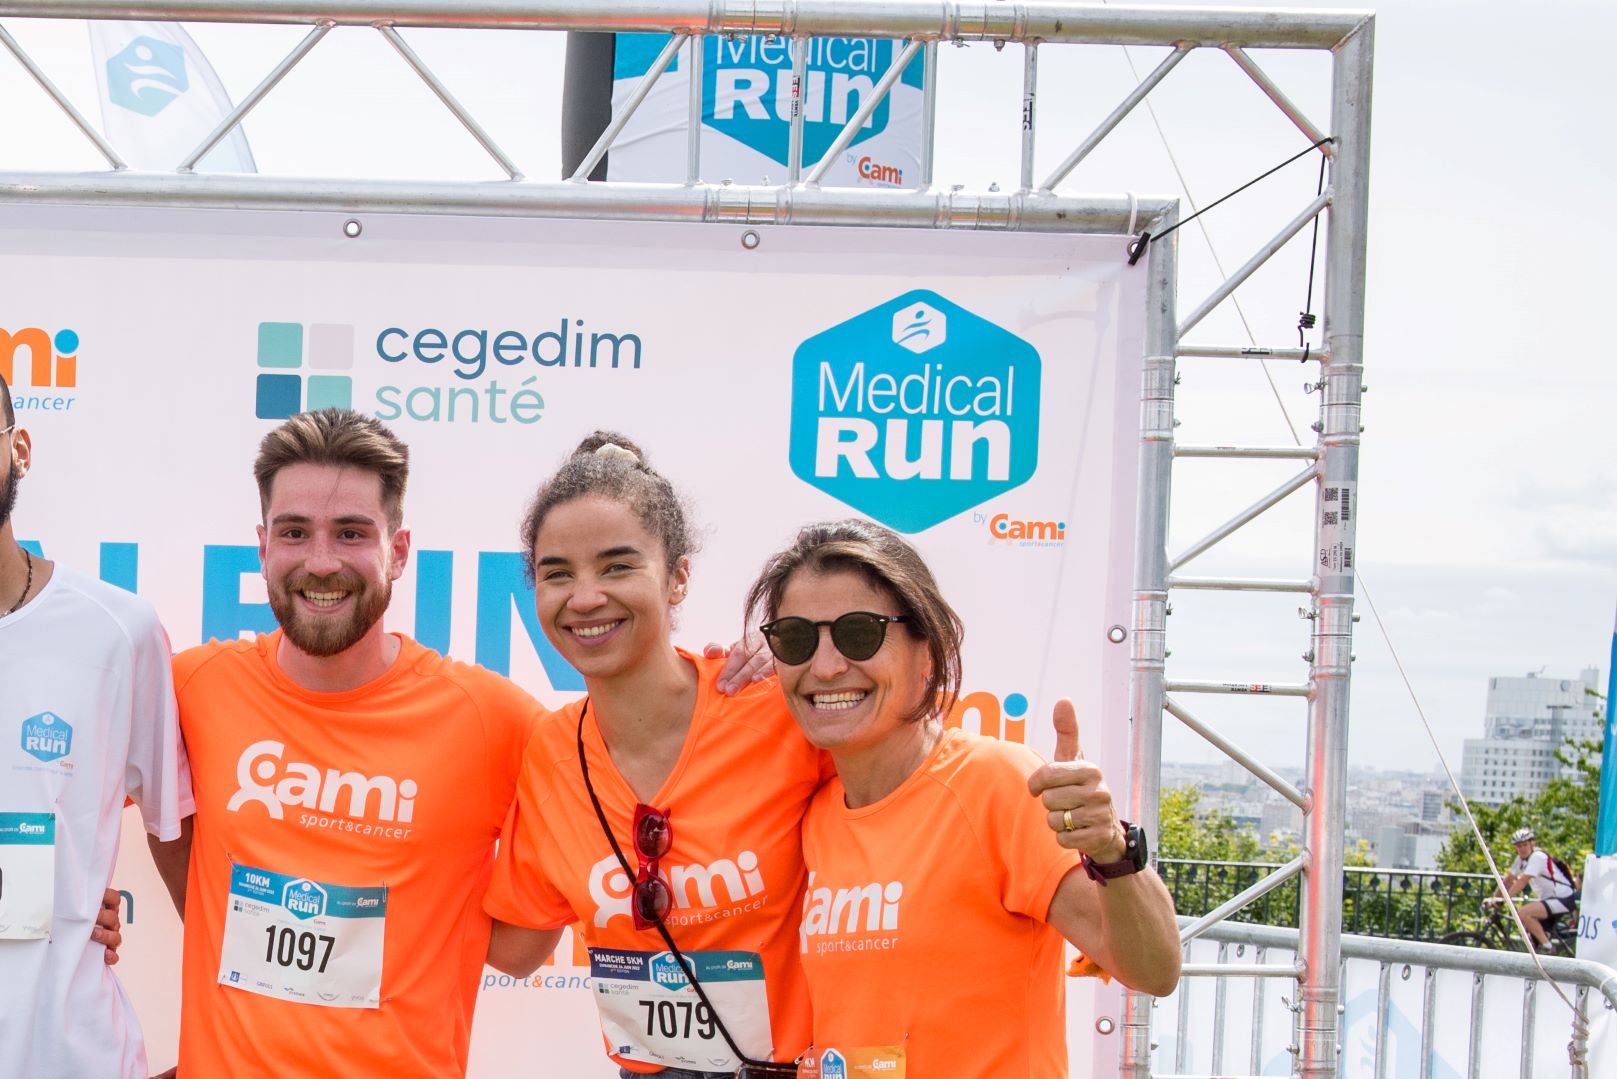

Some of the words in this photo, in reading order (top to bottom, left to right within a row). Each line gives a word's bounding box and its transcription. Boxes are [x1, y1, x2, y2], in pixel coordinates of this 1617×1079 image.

[714, 68, 877, 129] Run
[858, 157, 902, 184] Cami
[376, 318, 642, 380] cegedim
[374, 376, 545, 424] santé
[818, 361, 1014, 416] Medical
[815, 416, 1011, 481] Run
[973, 511, 988, 526] by
[989, 513, 1066, 541] Cami
[26, 736, 66, 755] Run
[27, 725, 67, 741] Medical
[235, 740, 418, 823] Cami
[300, 812, 412, 839] sport&cancer
[245, 872, 270, 888] 10KM
[287, 900, 319, 914] Run
[289, 888, 320, 904] Medical
[800, 872, 903, 936] ami
[266, 925, 336, 973] 1097
[594, 953, 625, 965] MARCHE
[626, 956, 644, 966] 5KM
[816, 937, 898, 957] sport&cancer
[639, 1000, 716, 1040] 7079
